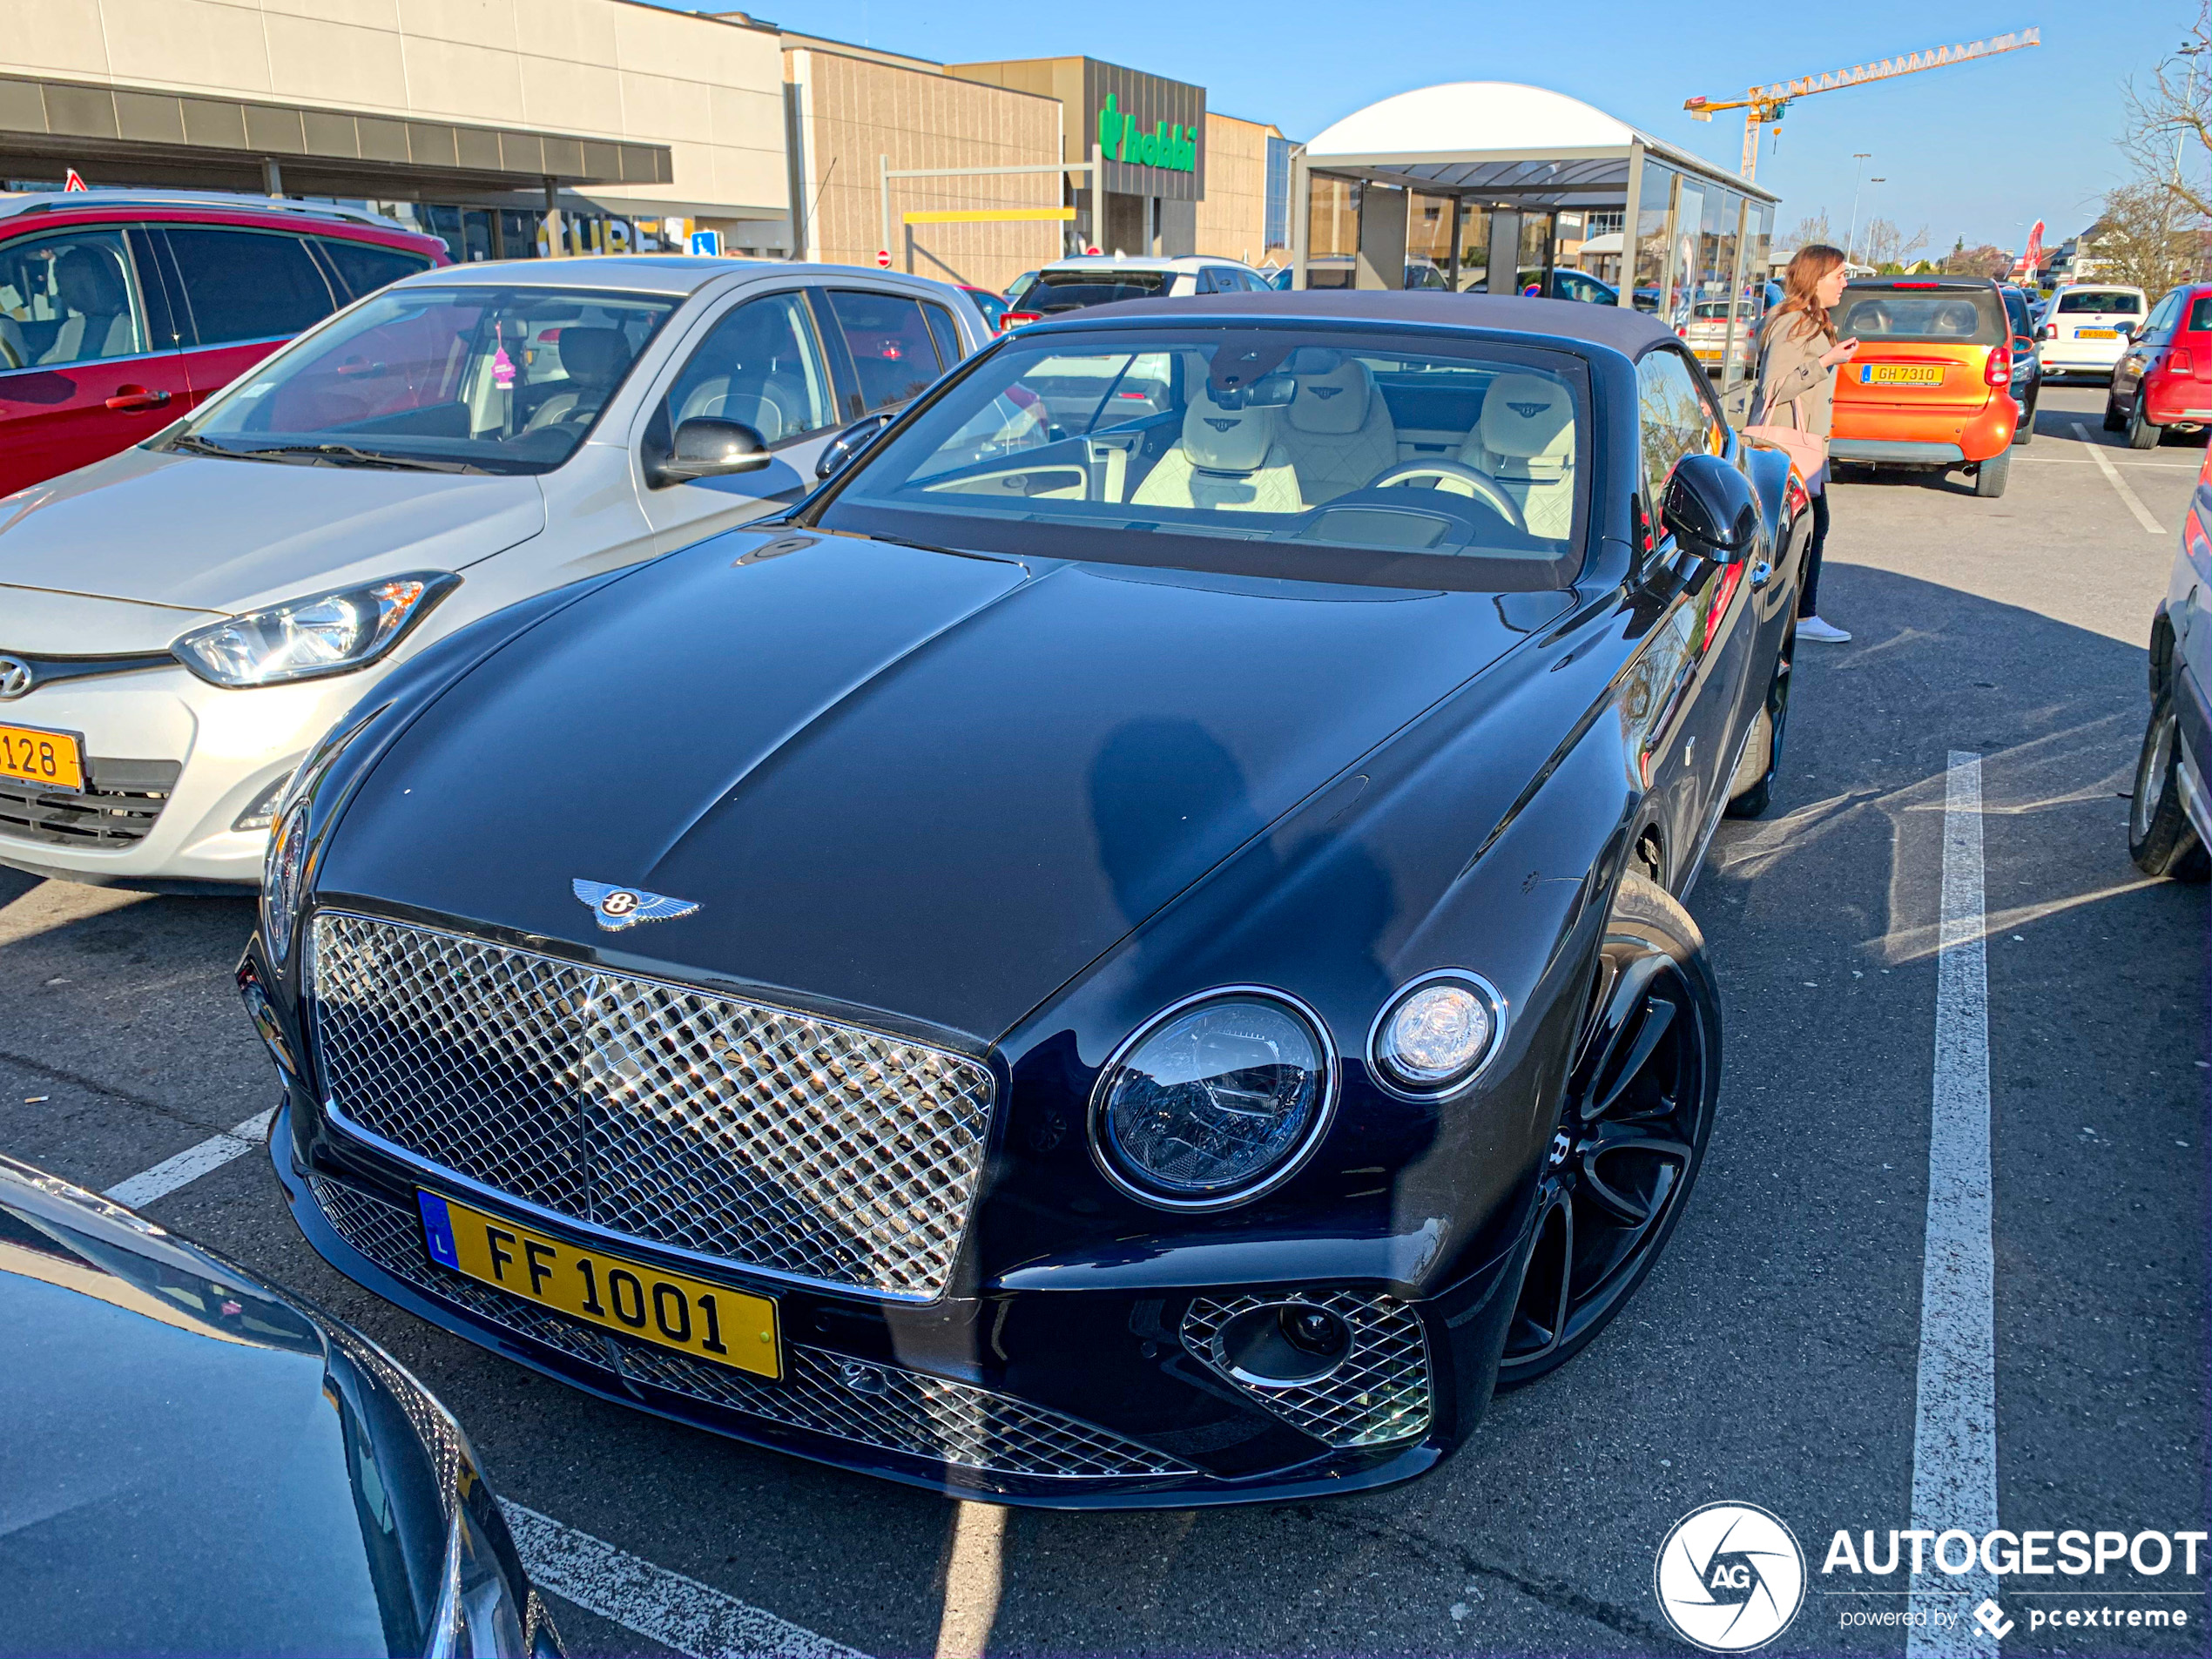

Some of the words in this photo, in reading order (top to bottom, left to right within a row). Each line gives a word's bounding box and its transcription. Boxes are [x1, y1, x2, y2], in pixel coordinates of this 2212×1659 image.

[1879, 368, 1897, 380] GH
[1901, 368, 1935, 381] 7310
[0, 735, 57, 777] 128
[435, 1234, 448, 1256] L
[485, 1223, 557, 1296] FF
[576, 1258, 729, 1356] 1001
